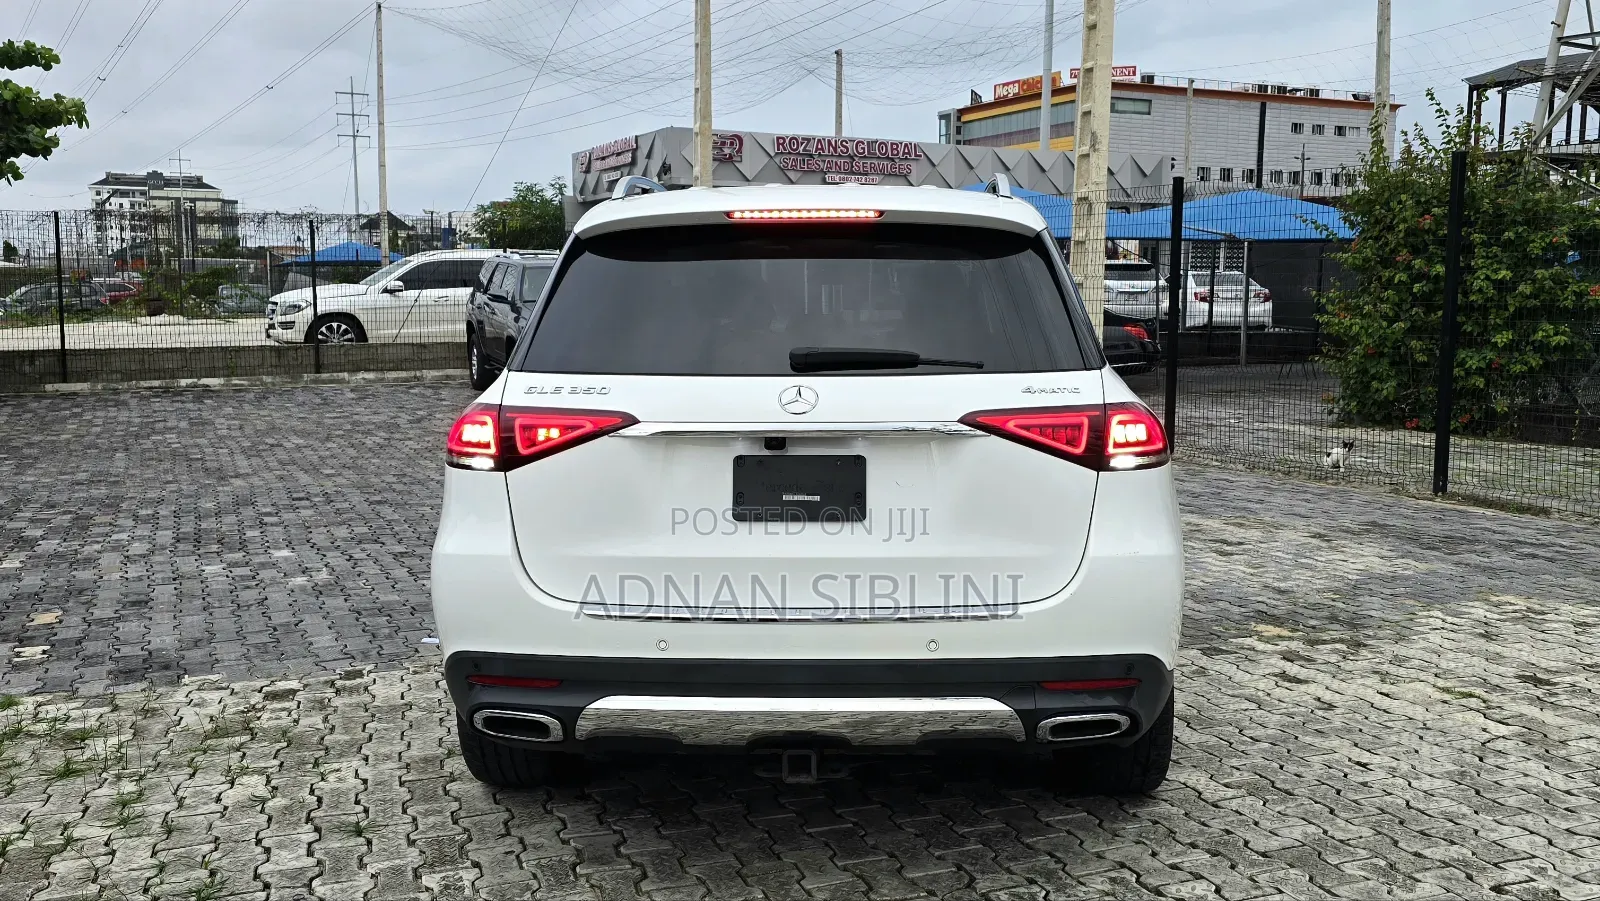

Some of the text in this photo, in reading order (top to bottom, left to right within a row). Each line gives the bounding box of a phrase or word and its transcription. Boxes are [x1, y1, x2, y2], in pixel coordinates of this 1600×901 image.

[995, 83, 1019, 99] Mega
[774, 135, 923, 159] ROZANS GLOBAL
[781, 156, 912, 175] SALES AND SERVICES
[523, 386, 612, 396] GLE 350
